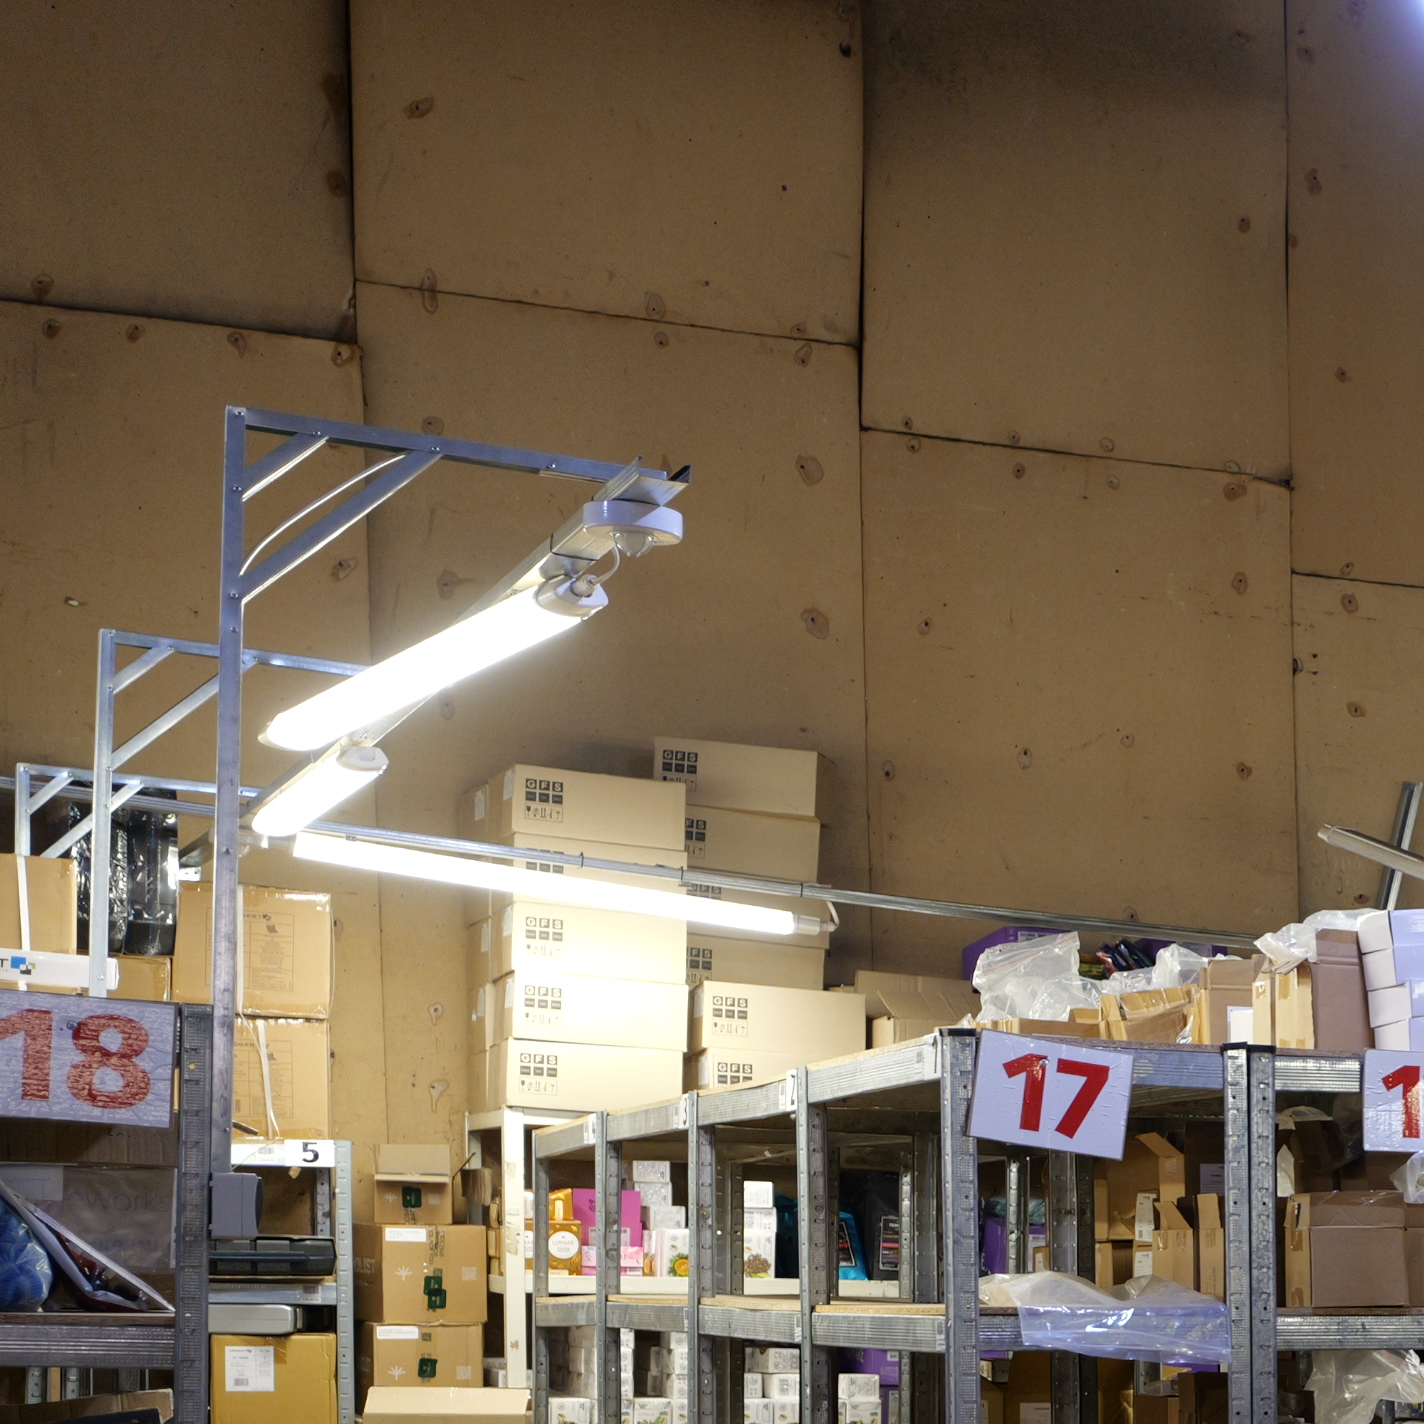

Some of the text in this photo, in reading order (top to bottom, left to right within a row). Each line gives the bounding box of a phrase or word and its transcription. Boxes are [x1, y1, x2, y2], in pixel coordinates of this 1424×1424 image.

[662, 749, 699, 762] GFS
[525, 778, 564, 792] GFS
[525, 917, 564, 931] GFS
[524, 986, 562, 999] GFS
[712, 995, 748, 1009] GFS
[0, 1008, 151, 1110] 18
[519, 1053, 558, 1066] GFS
[717, 1062, 753, 1074] GFS
[1002, 1052, 1111, 1139] 17
[301, 1142, 320, 1164] 5
